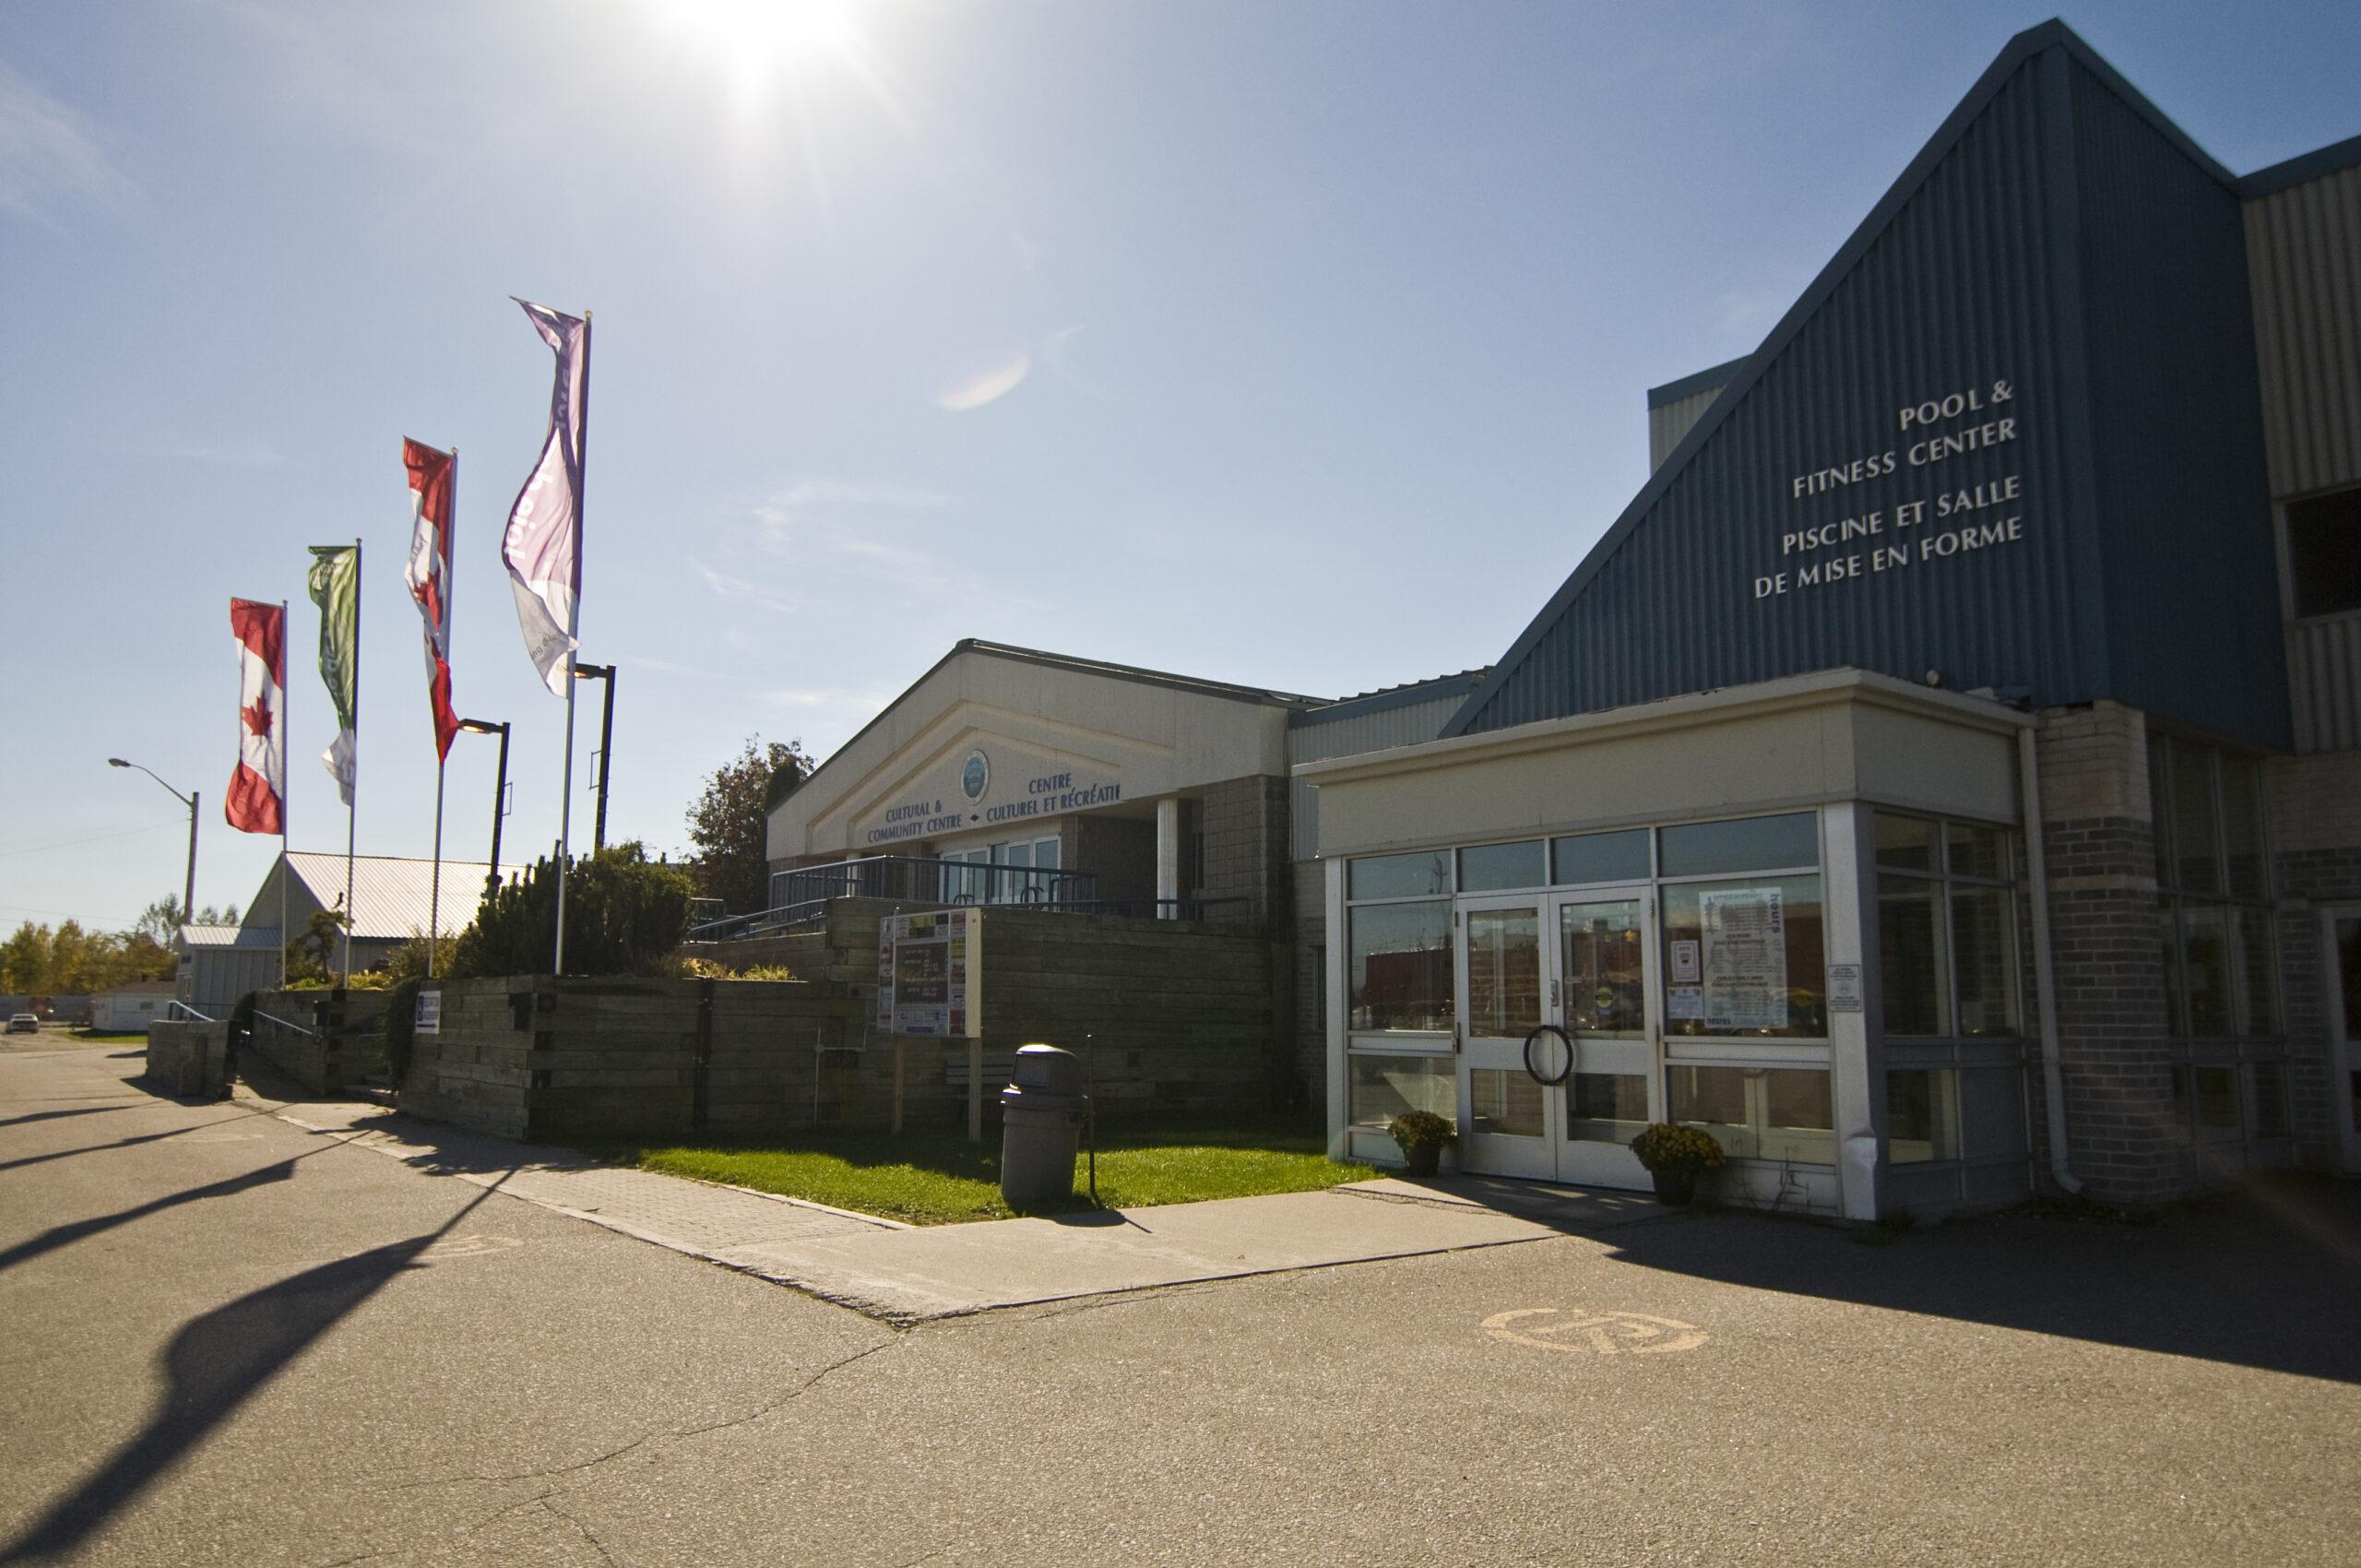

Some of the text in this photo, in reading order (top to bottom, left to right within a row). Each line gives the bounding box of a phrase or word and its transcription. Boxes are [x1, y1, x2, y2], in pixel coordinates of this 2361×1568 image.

[1899, 379, 2013, 431] POOL &
[1793, 418, 2017, 499] FITNESS CENTER
[1783, 475, 2020, 554] PISCINE ET SALLE
[1754, 517, 2023, 599] DE MISE EN FORME
[1029, 773, 1072, 794] CENTRE
[868, 814, 962, 842] COMMUNITY CENTRE
[885, 799, 942, 823] CULTURAL &
[987, 800, 1038, 822] CULTUREL
[1043, 796, 1056, 813] ET
[1770, 893, 1781, 933] hours
